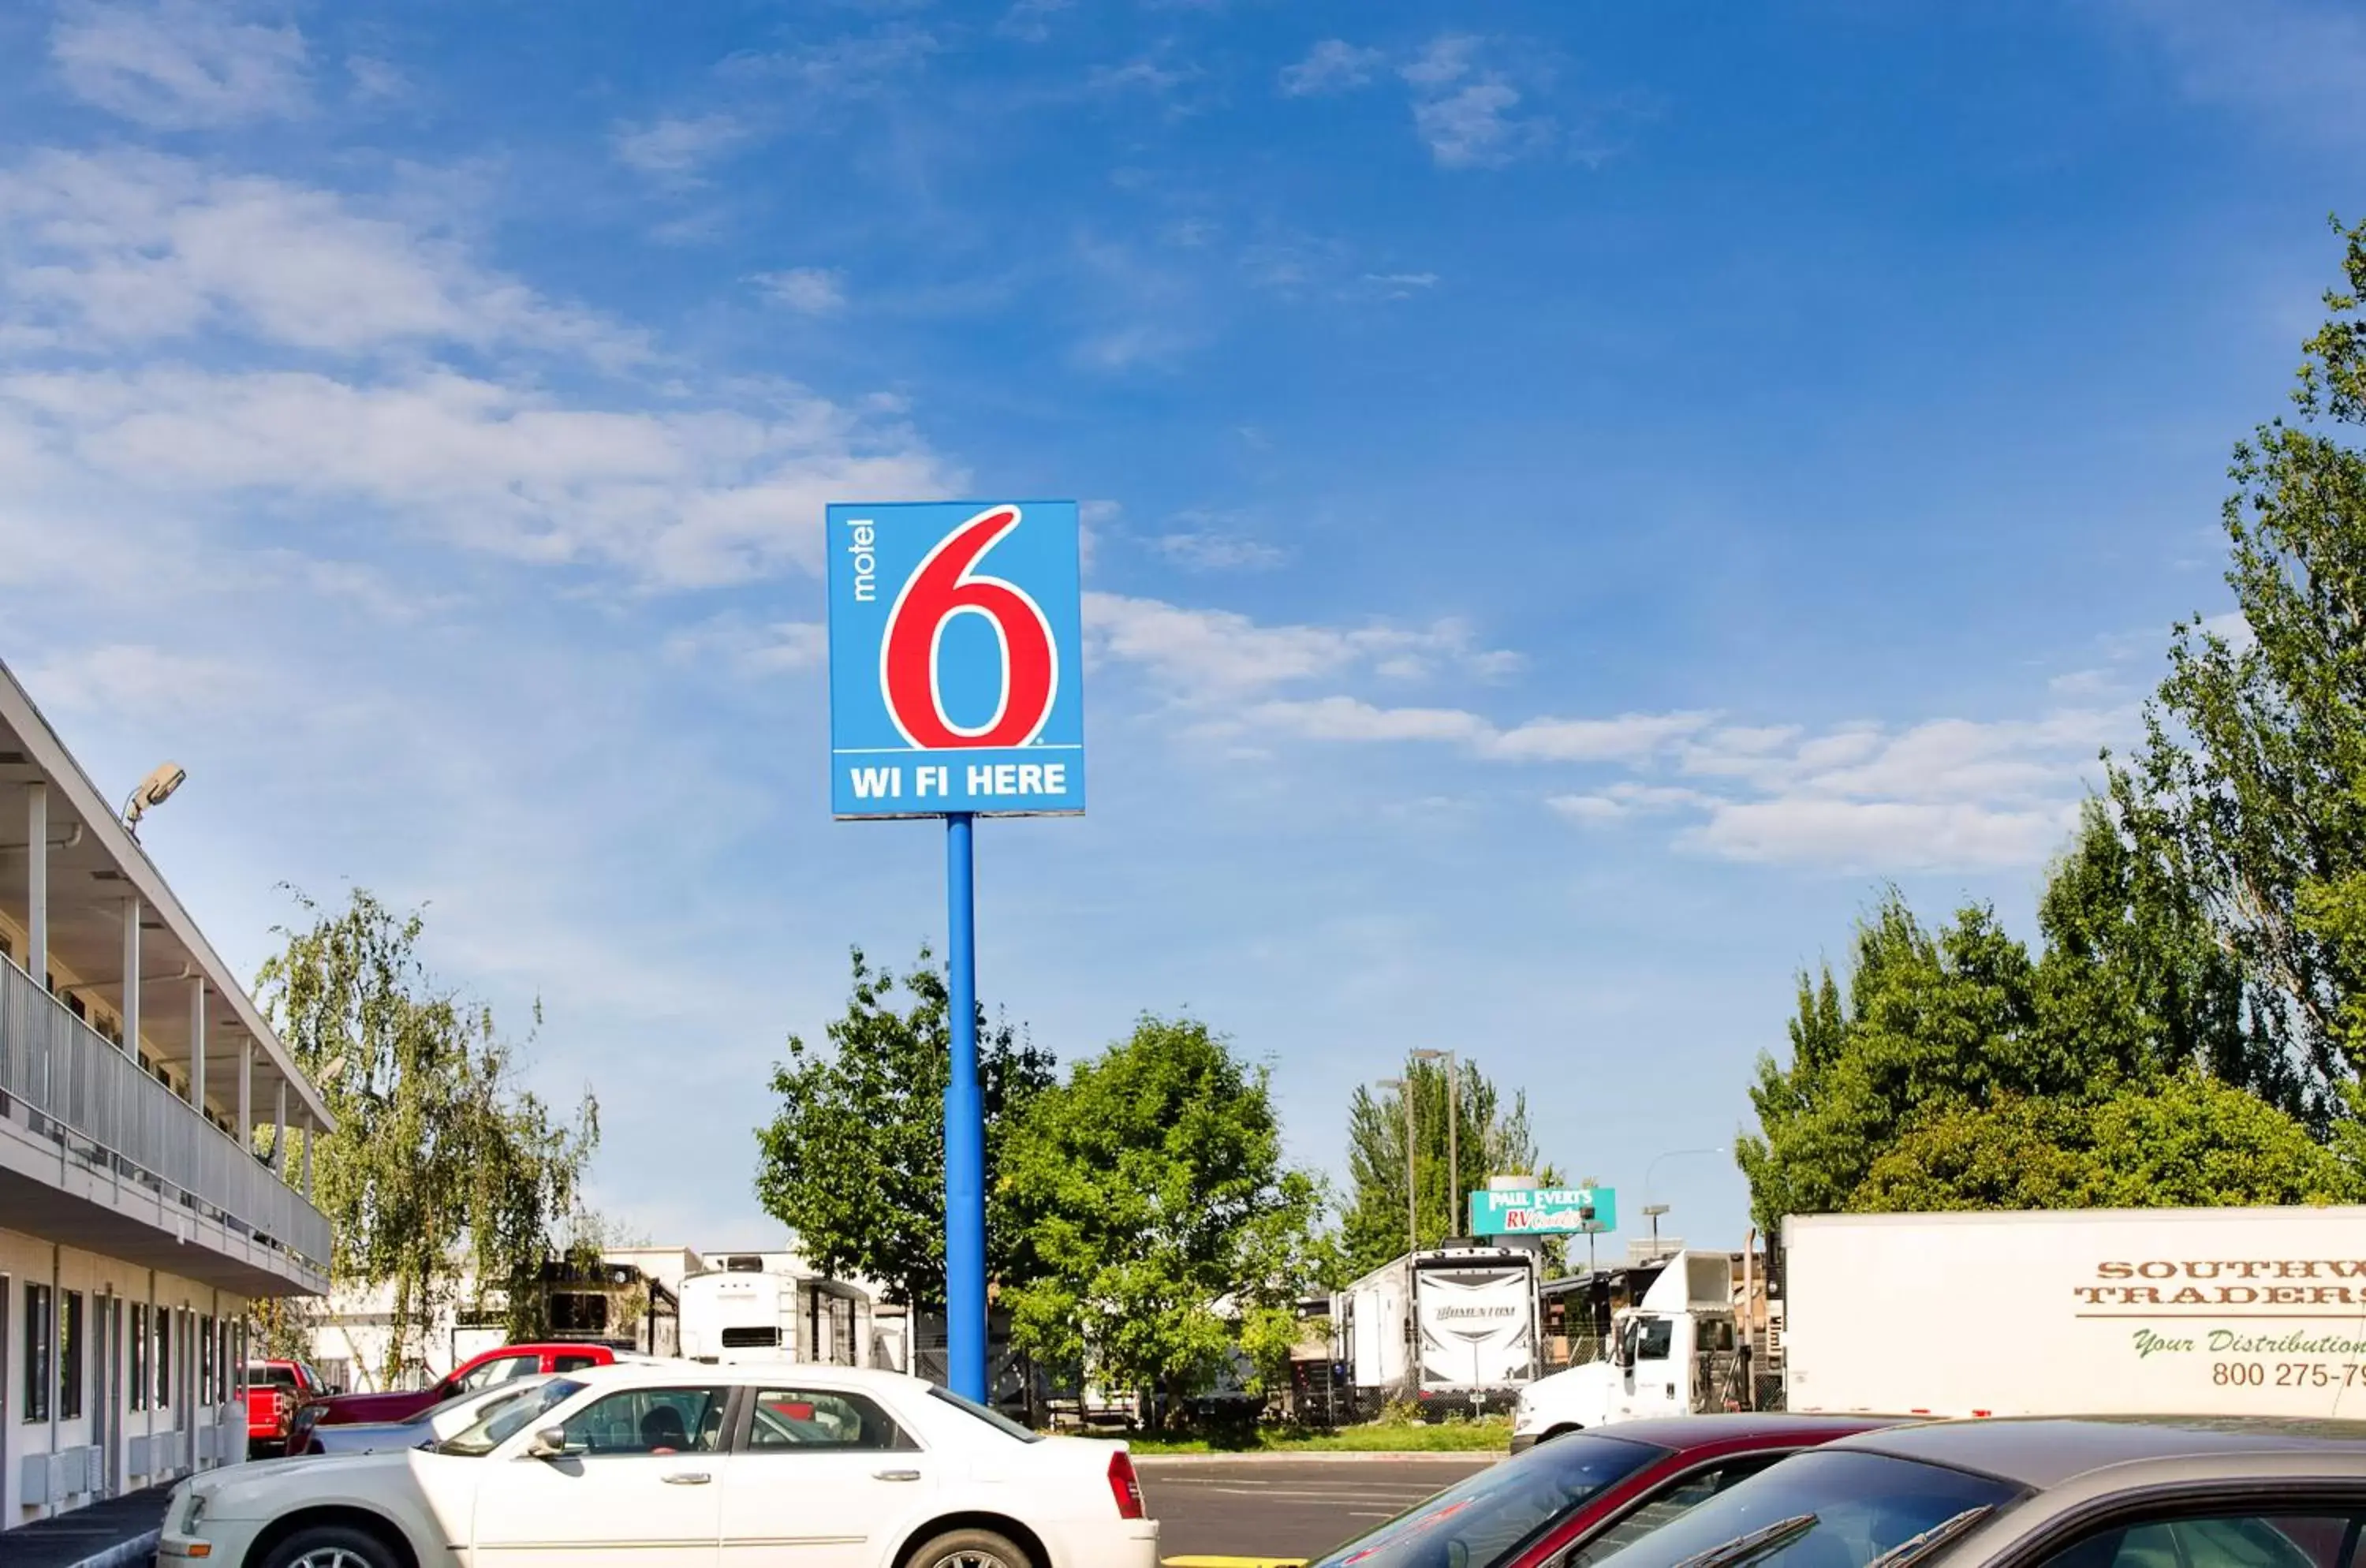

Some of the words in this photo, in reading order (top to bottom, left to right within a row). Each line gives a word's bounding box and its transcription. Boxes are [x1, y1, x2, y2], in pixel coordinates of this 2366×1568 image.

[846, 519, 875, 601] motel
[879, 505, 1058, 749] 6
[850, 767, 901, 798] WI
[916, 765, 948, 797] FI
[967, 763, 1067, 796] HERE
[1489, 1192, 1531, 1211] PAUL
[1506, 1209, 1532, 1230] RV
[2074, 1286, 2366, 1304] TRADER
[2133, 1328, 2196, 1359] Your
[2212, 1362, 2265, 1387] 800
